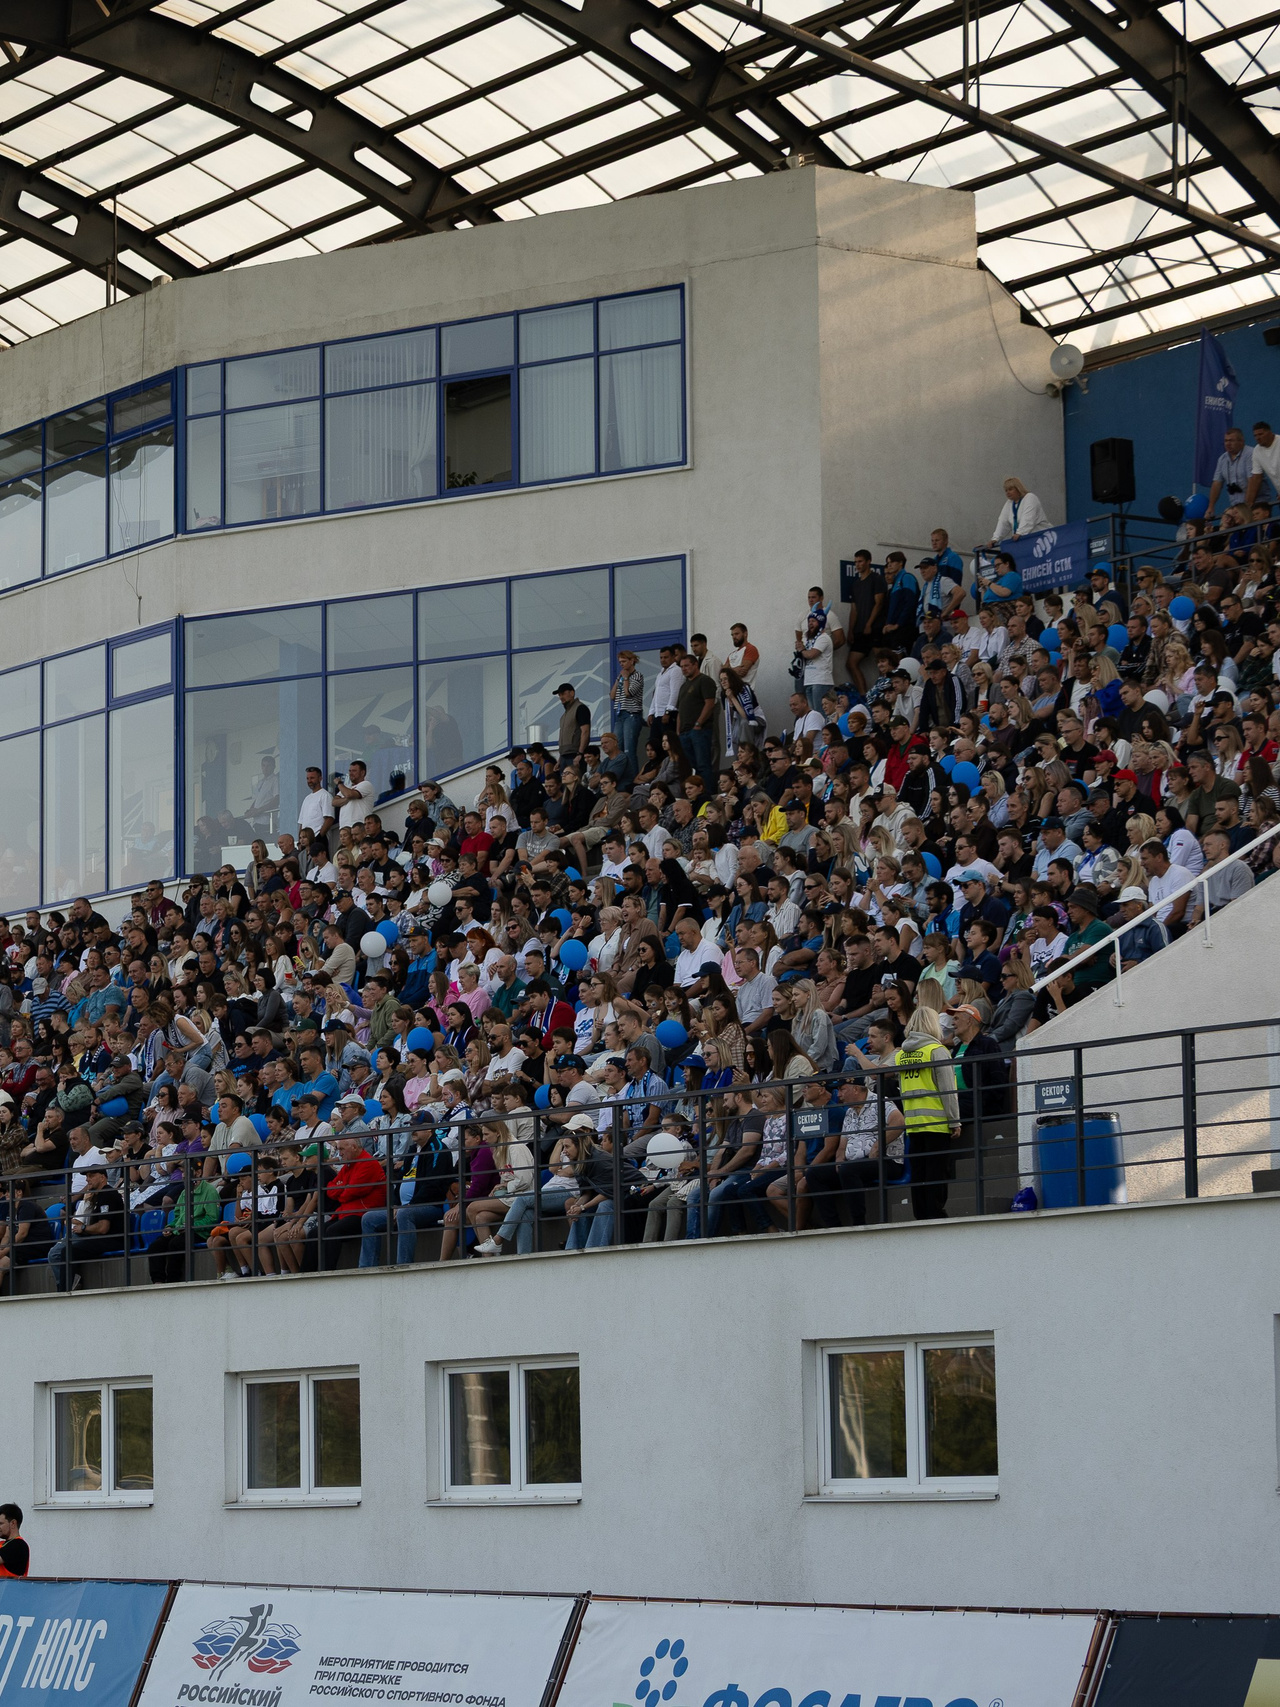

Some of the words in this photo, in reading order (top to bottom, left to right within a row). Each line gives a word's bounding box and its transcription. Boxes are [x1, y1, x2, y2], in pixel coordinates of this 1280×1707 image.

[1022, 559, 1053, 582] ЕНИСЕЙ
[1054, 556, 1072, 573] СТМ
[1041, 1085, 1065, 1097] СЕКТОР
[1065, 1084, 1070, 1094] 6
[797, 1114, 818, 1125] СЕКТОР
[818, 1113, 823, 1123] 5
[21, 1618, 108, 1692] НОКС
[319, 1656, 396, 1671] МЕРОПРИЯТИЕ
[396, 1660, 469, 1674] ПРОВОДИТСЯ
[314, 1670, 337, 1682] ПРИ
[337, 1672, 402, 1686] ПОДДЕРЖКЕ
[177, 1683, 282, 1707] РОССИЙСКИЙ
[309, 1684, 386, 1700] РОССИЙСКОГО
[386, 1689, 464, 1704] СПОРТИВНОГО
[465, 1694, 506, 1707] ФОНДА
